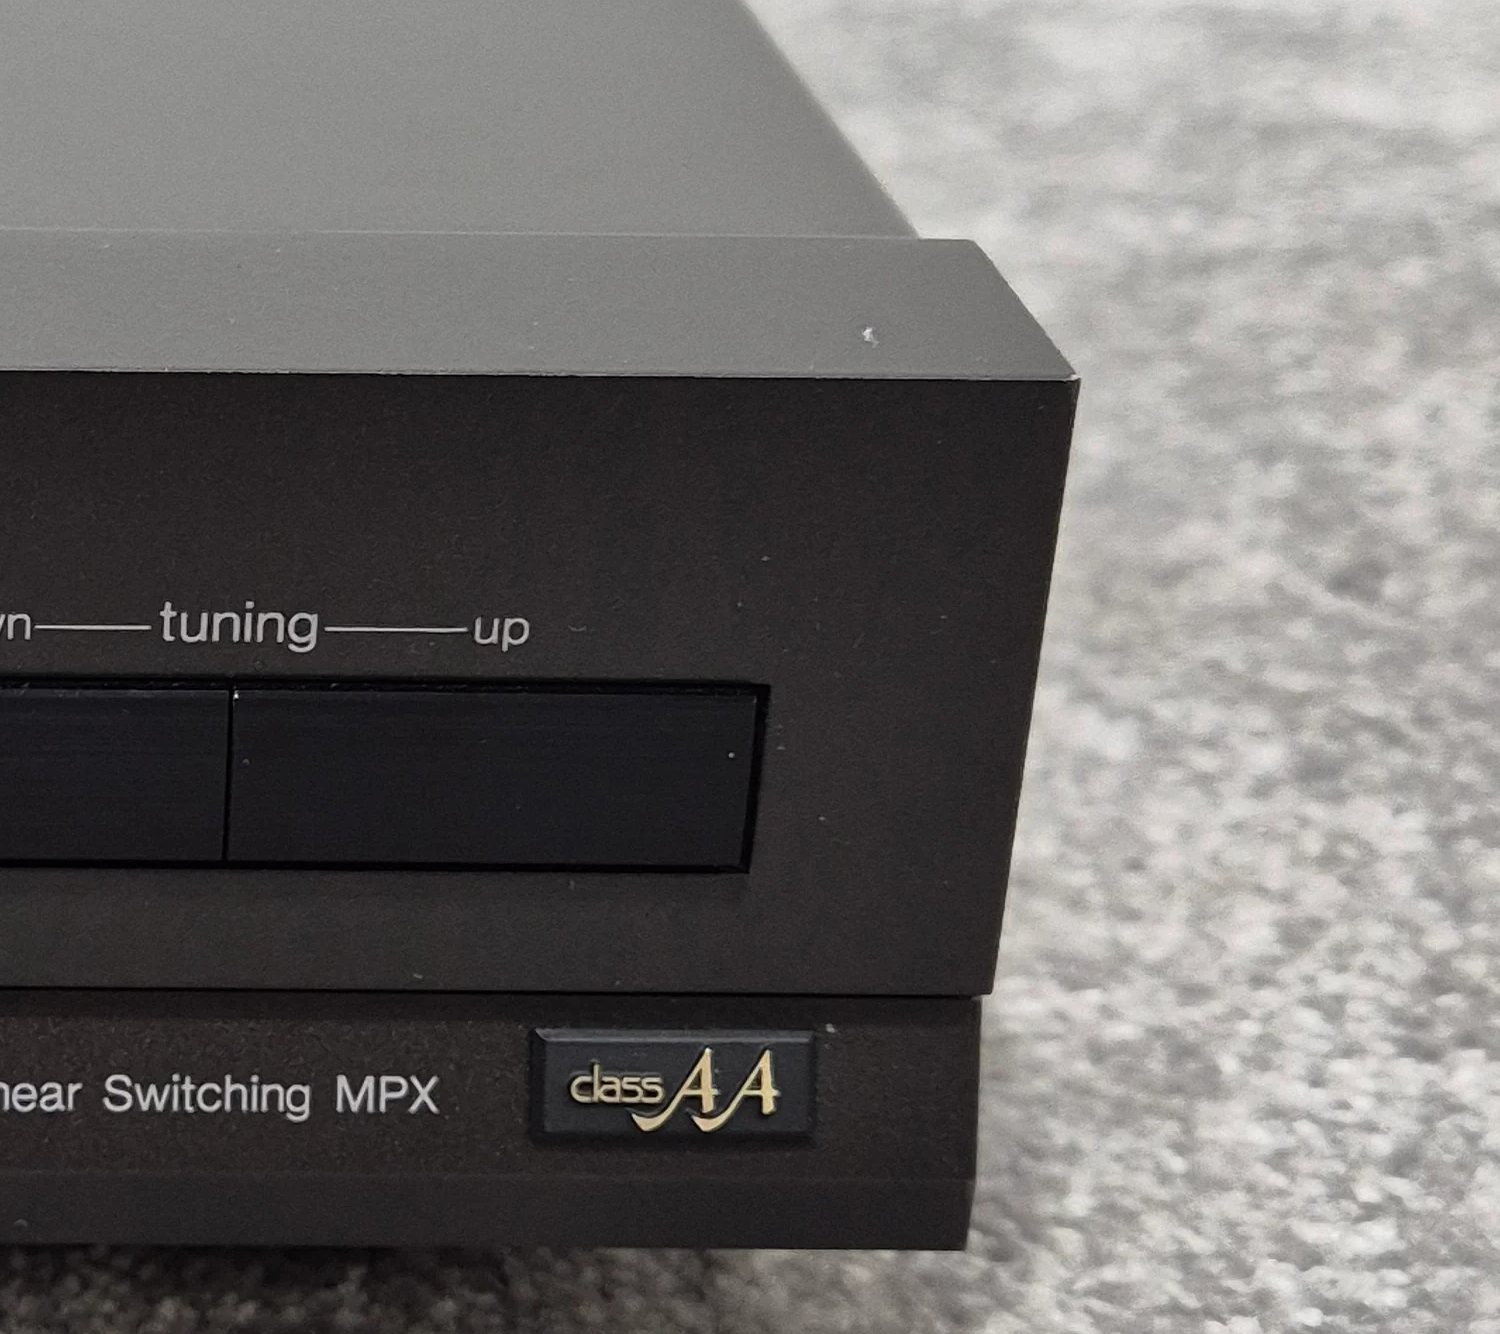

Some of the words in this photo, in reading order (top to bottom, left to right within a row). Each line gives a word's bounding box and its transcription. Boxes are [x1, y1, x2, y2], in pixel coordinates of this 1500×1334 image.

[160, 601, 319, 652] tuning
[473, 613, 530, 651] up
[103, 1074, 311, 1122] Switching
[335, 1076, 439, 1115] MPX
[570, 1066, 664, 1105] class
